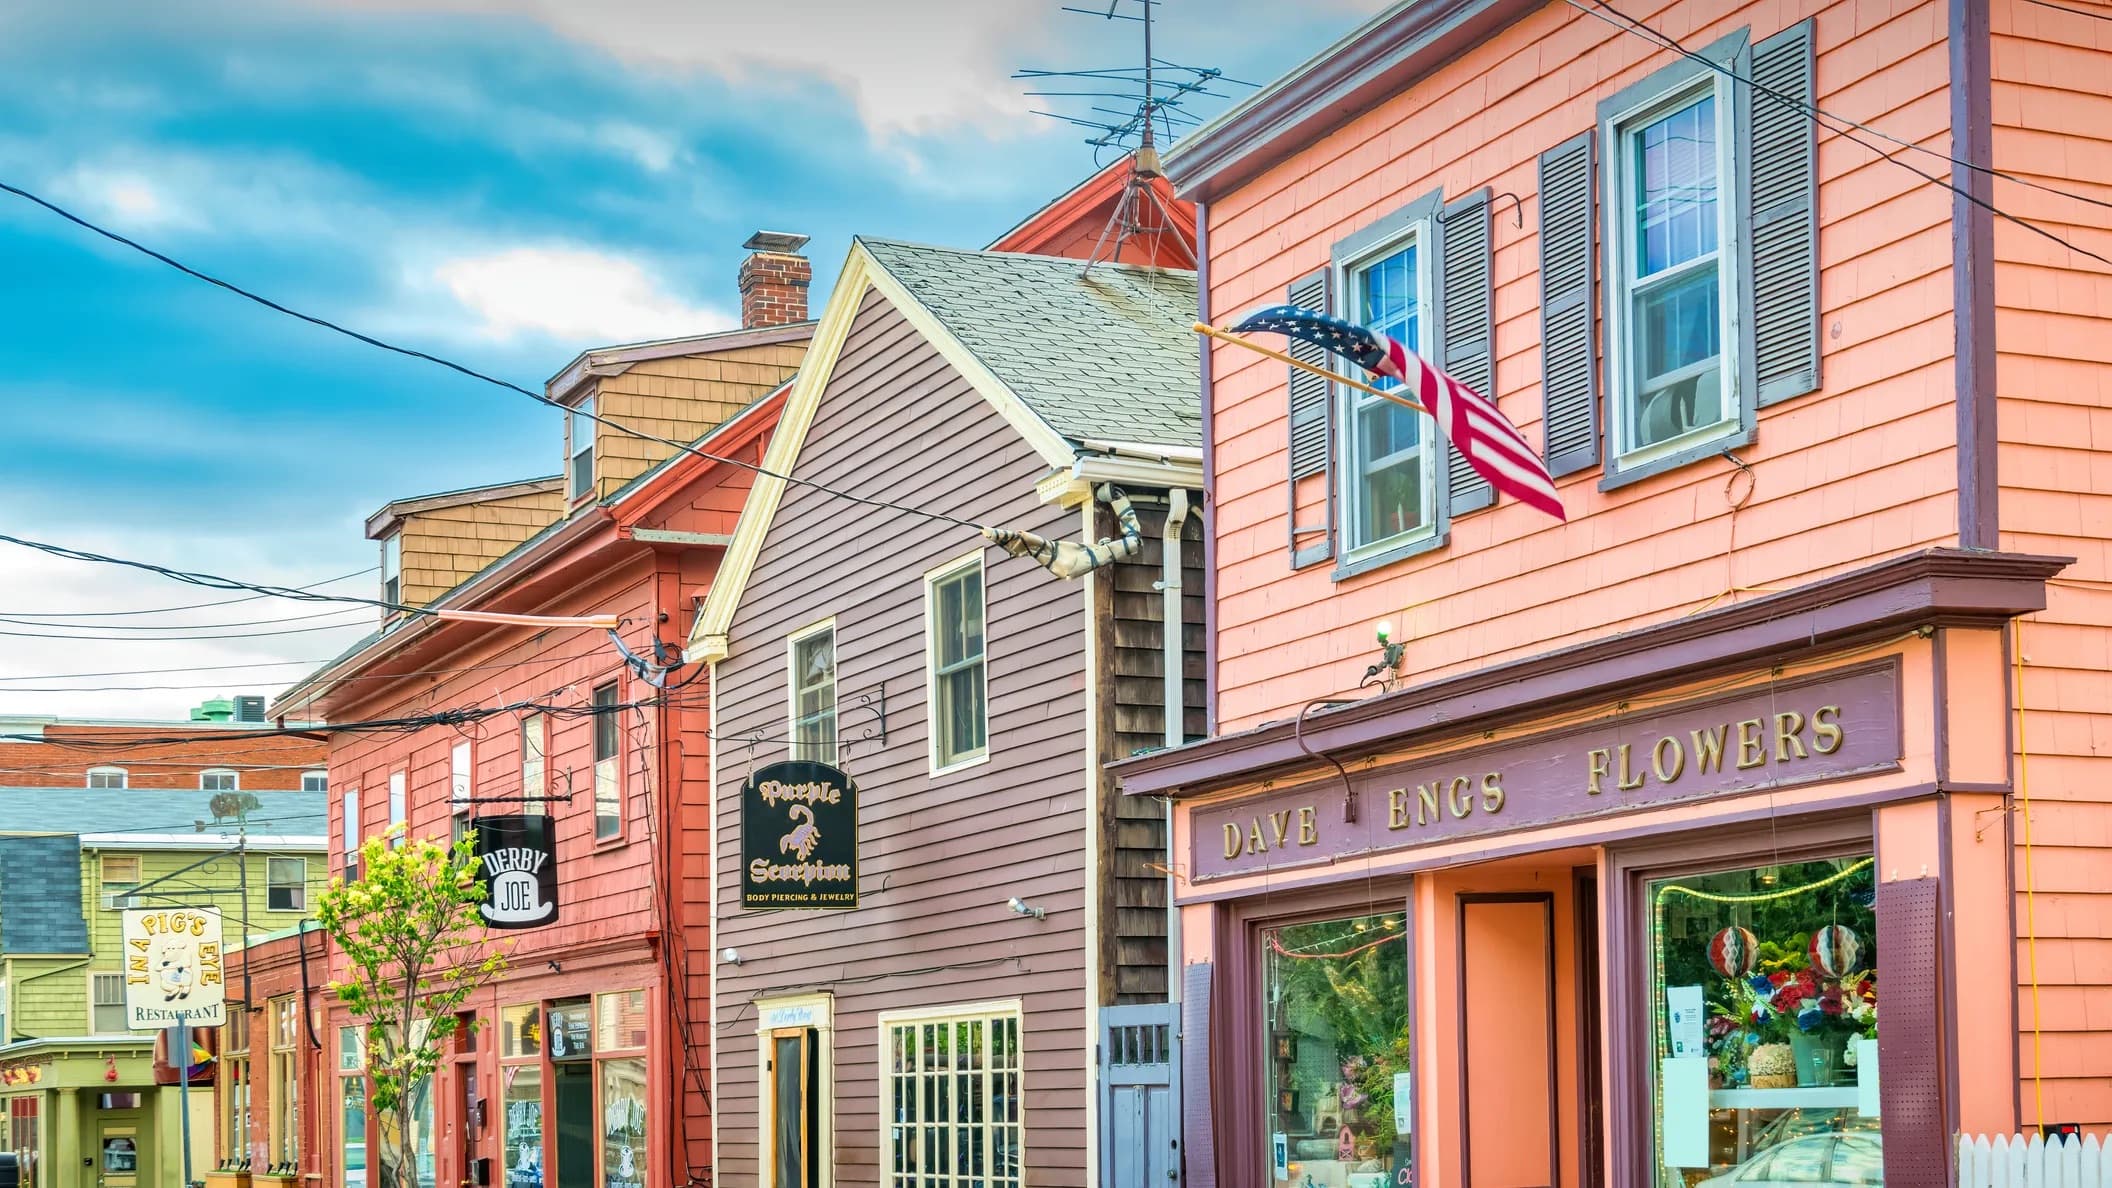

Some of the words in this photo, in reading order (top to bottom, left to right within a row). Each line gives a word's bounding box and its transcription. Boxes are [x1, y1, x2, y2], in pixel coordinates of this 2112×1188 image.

[759, 780, 841, 807] Purple
[1223, 806, 1318, 860] DAVE
[1387, 772, 1505, 830] ENGS
[1587, 705, 1844, 795] FLOWERS
[482, 847, 548, 877] DERBY
[750, 858, 851, 887] Scorpion
[501, 881, 531, 911] JOE
[746, 894, 769, 902] BODY
[771, 893, 808, 902] PIERCING
[810, 893, 817, 902] &
[819, 893, 854, 902] JEWELRY
[141, 912, 207, 936] PIG'S
[198, 941, 222, 986] EYE
